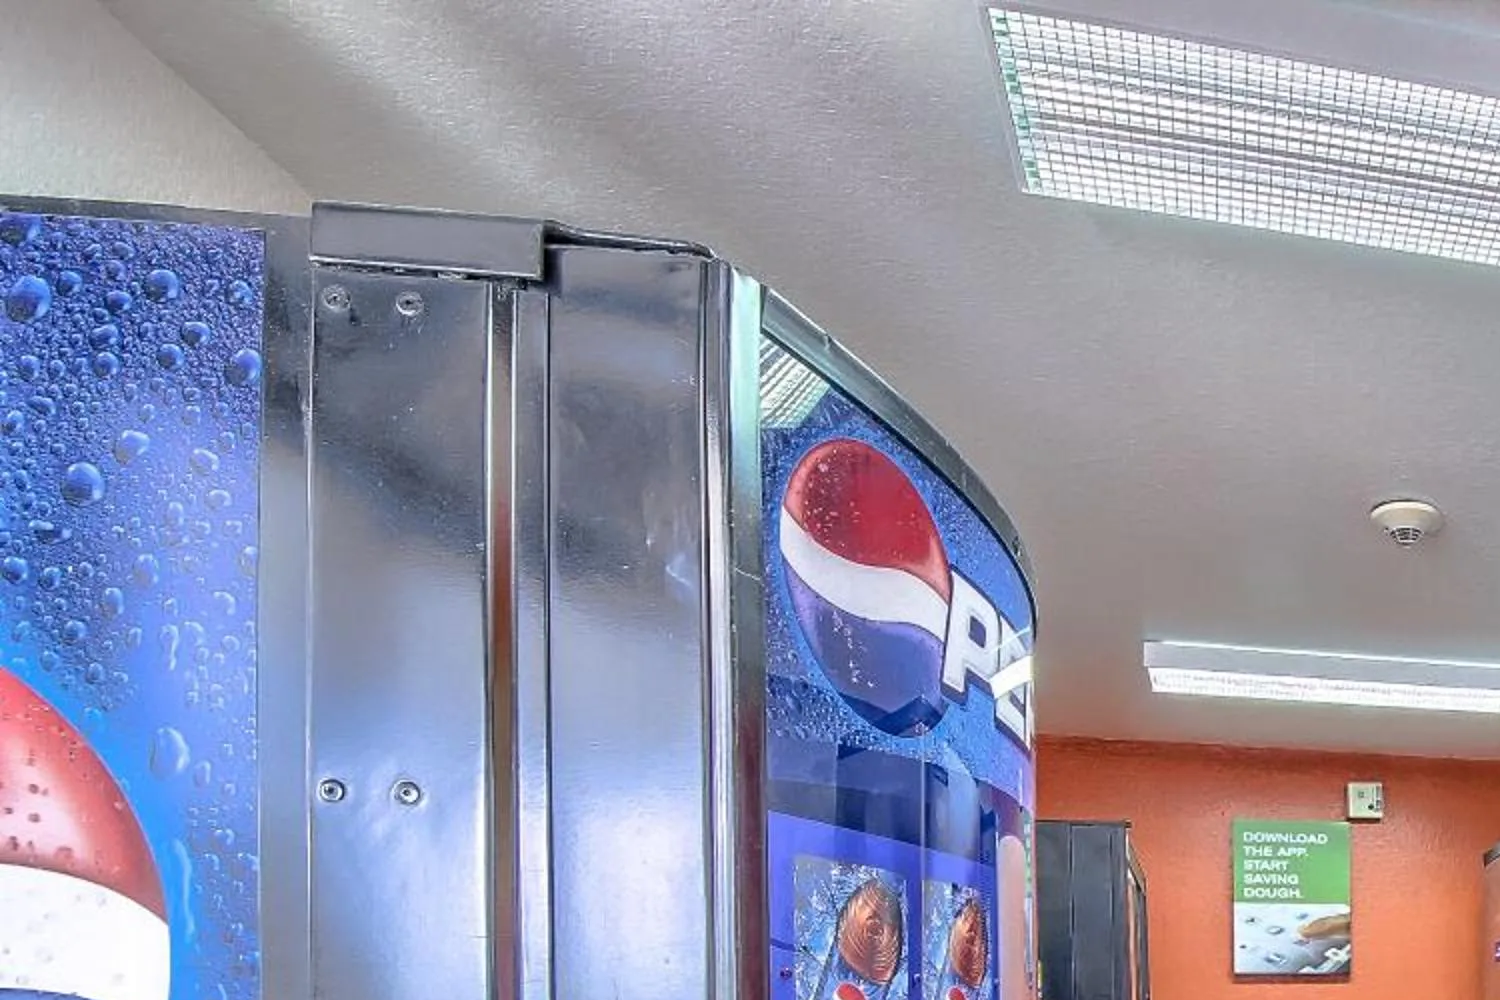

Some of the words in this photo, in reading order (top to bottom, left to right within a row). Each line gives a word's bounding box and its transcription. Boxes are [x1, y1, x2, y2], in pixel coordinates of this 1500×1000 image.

[1243, 832, 1328, 845] DOWNLOAD
[1243, 845, 1273, 856] THE
[1277, 847, 1309, 857] APP.
[1243, 859, 1289, 871] START
[1243, 873, 1299, 885] SAVING
[1243, 887, 1304, 899] DOUGH.
